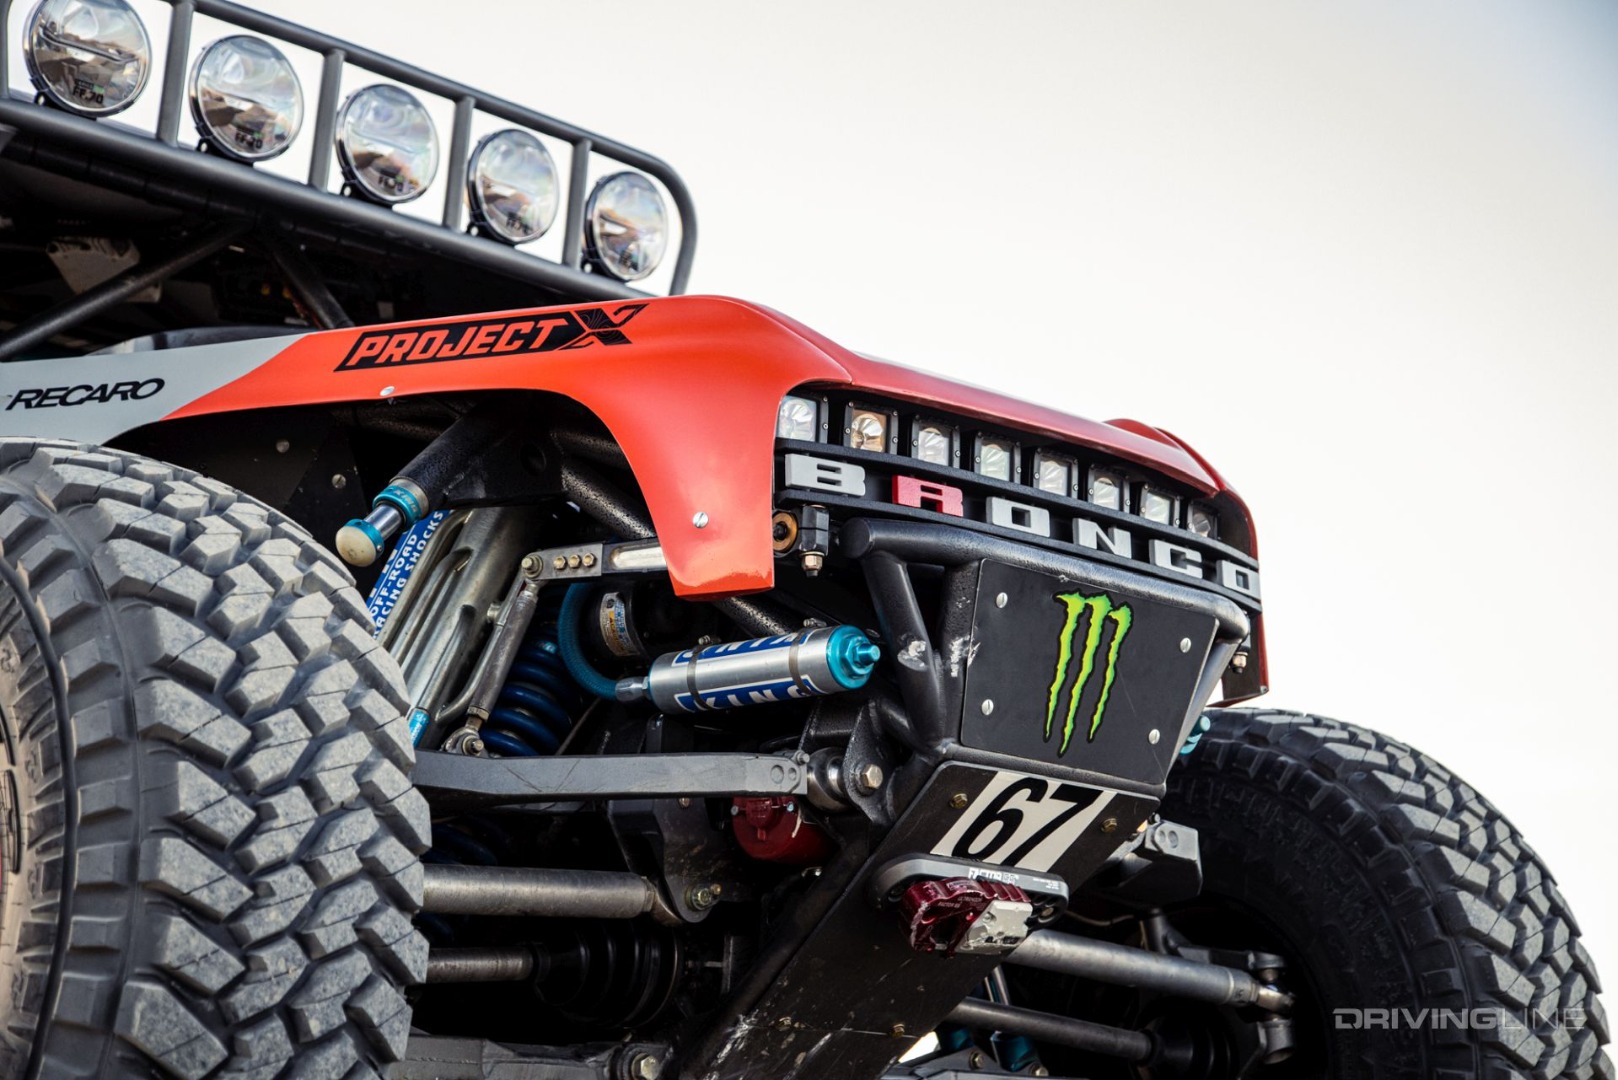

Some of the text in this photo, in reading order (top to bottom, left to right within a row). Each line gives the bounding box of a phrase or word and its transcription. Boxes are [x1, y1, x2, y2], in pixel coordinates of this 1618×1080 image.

[346, 317, 570, 367] PROJECT
[5, 378, 165, 411] RECARO
[405, 511, 444, 574] SHOCKS
[785, 453, 1260, 602] BRONCO
[370, 534, 418, 617] OFF-ROAD
[951, 777, 1104, 868] 67
